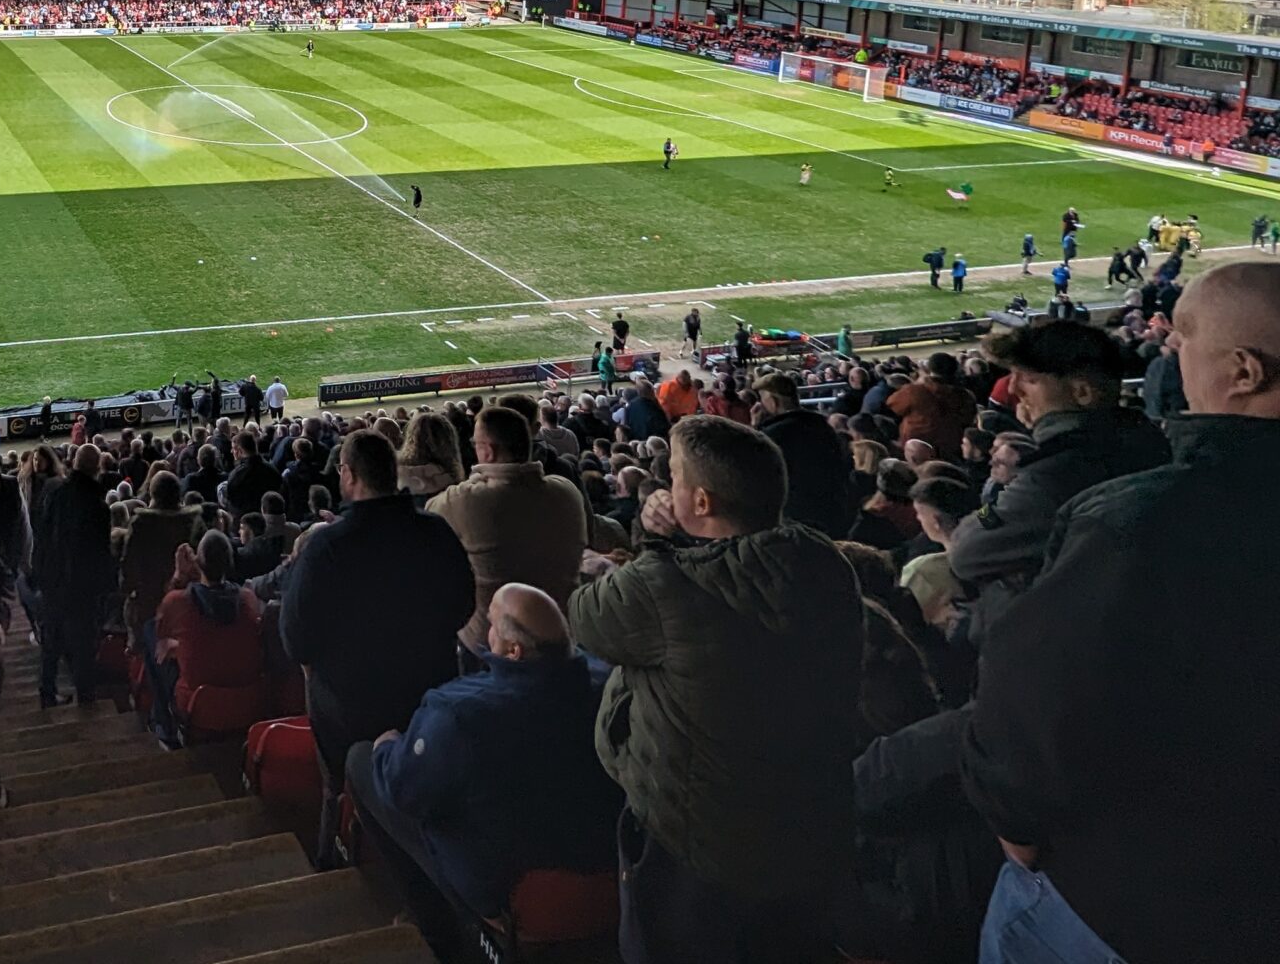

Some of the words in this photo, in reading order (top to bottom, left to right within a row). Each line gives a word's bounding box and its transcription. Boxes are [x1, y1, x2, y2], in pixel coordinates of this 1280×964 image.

[928, 6, 980, 21] Independent
[982, 14, 1010, 25] British
[1012, 18, 1043, 29] Millers
[1053, 22, 1078, 33] 1675
[1236, 44, 1258, 54] The
[1192, 52, 1243, 72] FAMILY
[957, 100, 968, 109] ICE
[968, 101, 992, 113] CREAM
[992, 107, 1010, 117] VANS
[1060, 118, 1084, 129] CCL
[326, 383, 367, 395] HEALDS
[368, 377, 421, 391] FLOORING
